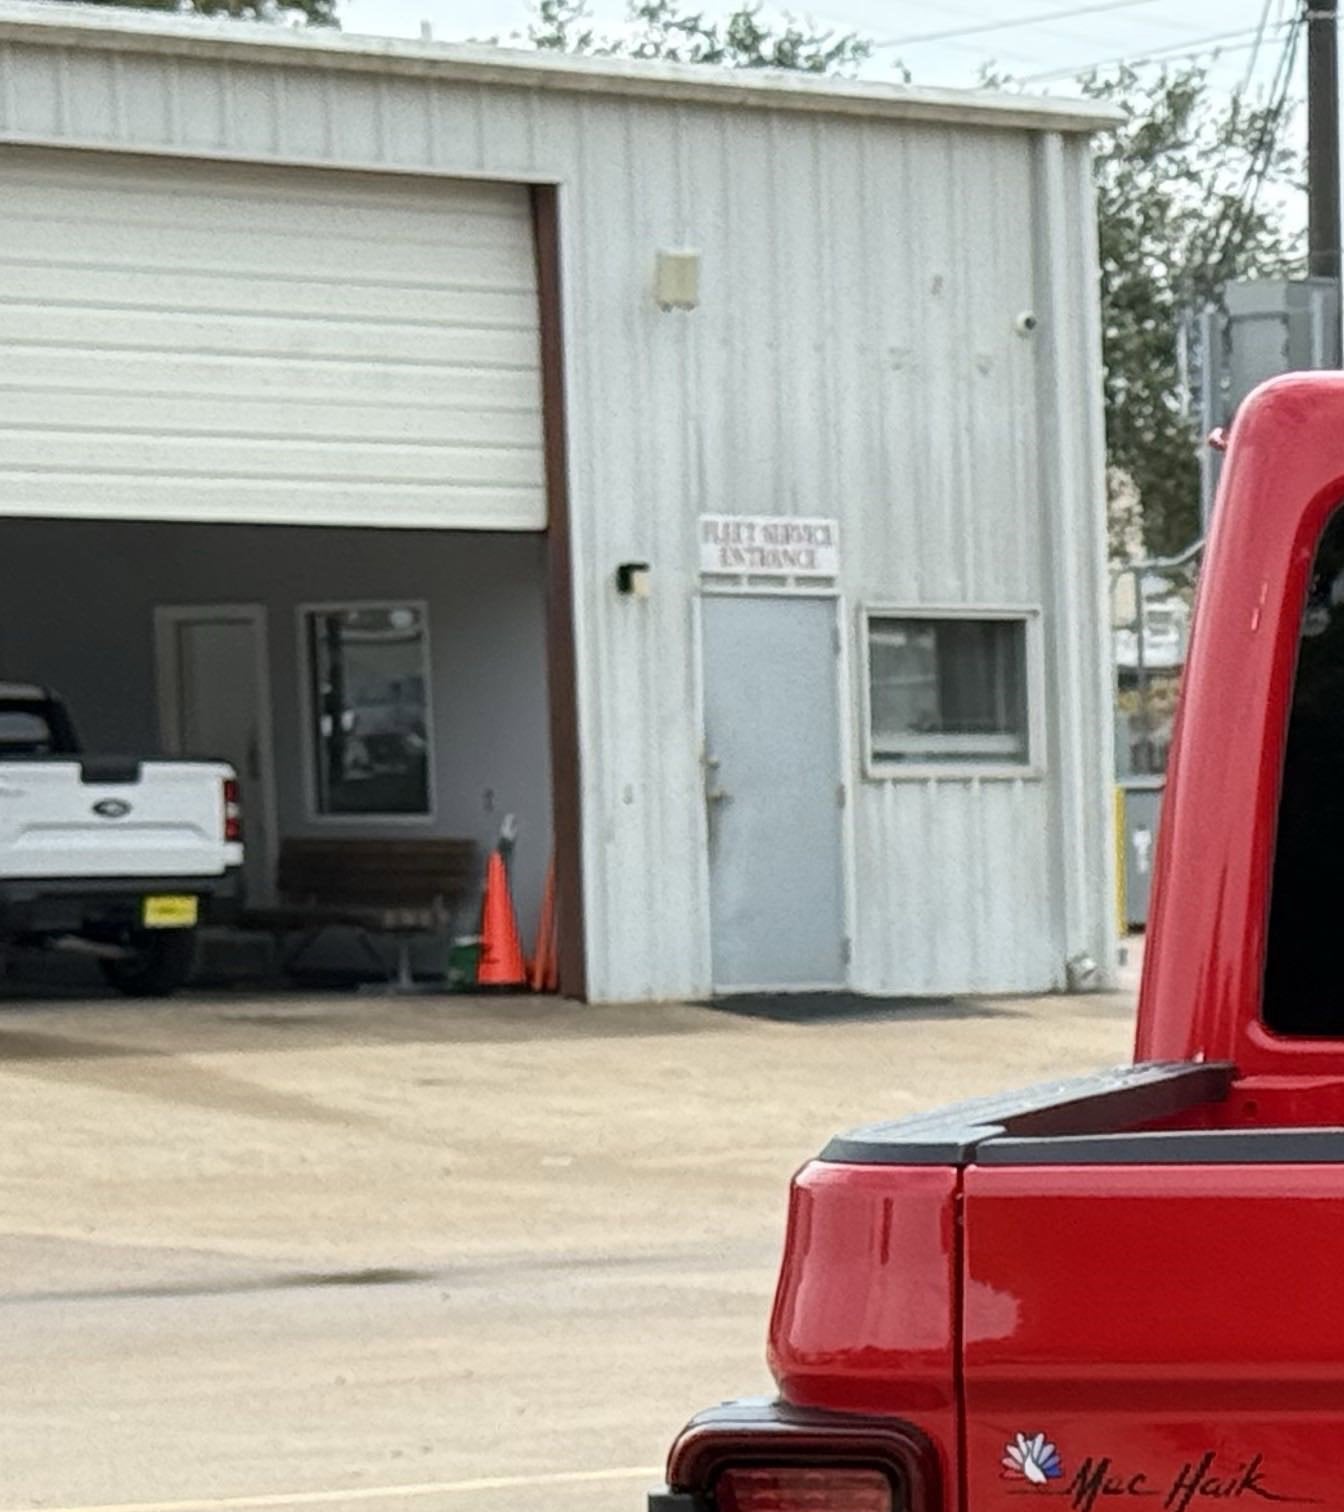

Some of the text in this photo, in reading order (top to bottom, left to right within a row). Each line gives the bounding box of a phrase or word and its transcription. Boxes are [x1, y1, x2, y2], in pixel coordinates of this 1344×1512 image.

[703, 520, 833, 546] FLEET SERVICE
[720, 546, 816, 569] ENTRANCE
